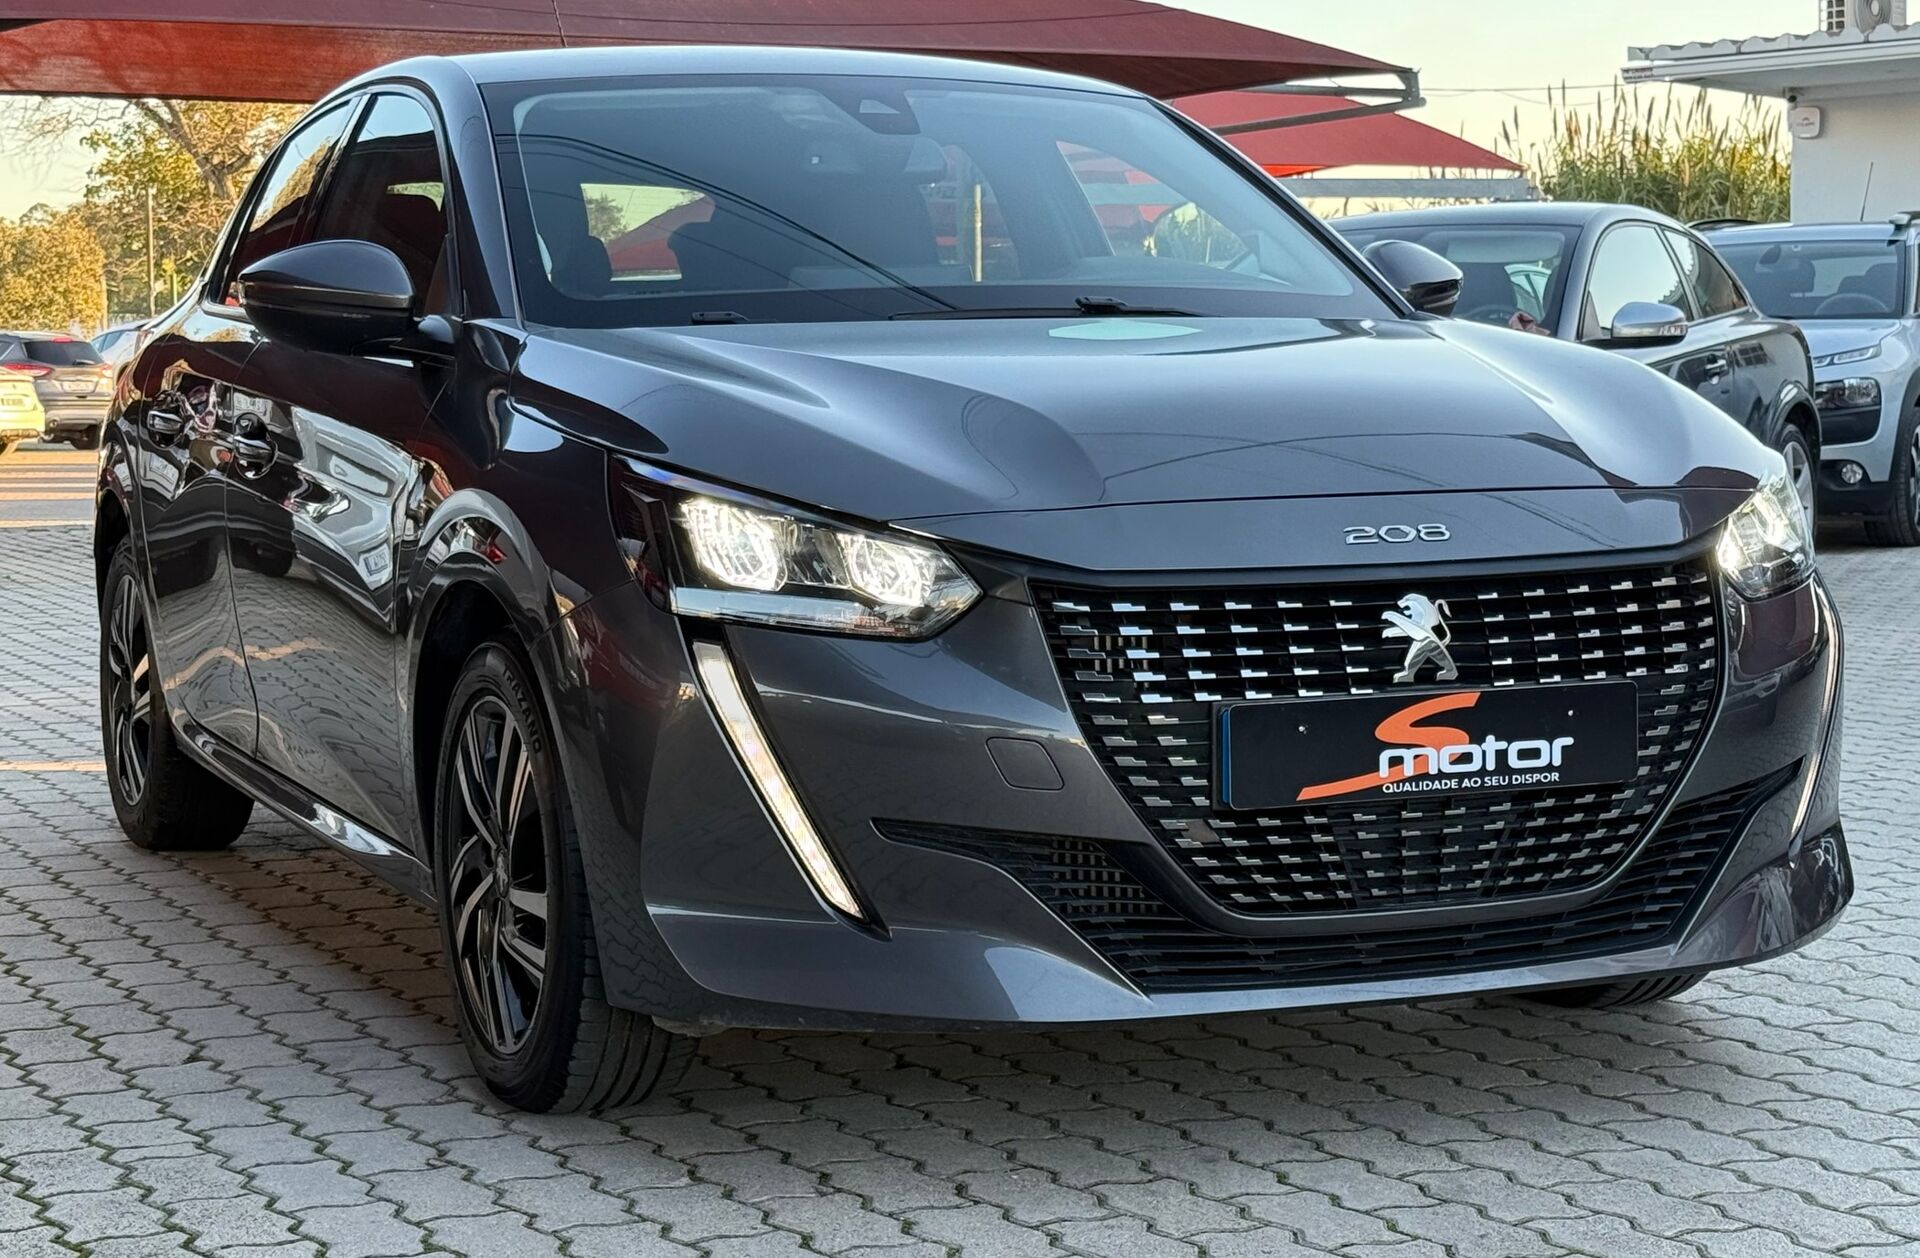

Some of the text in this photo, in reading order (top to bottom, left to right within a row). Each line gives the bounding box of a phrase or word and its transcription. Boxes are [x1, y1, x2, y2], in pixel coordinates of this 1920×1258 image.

[1344, 524, 1450, 544] 208
[503, 663, 542, 753] TRAZANO
[1379, 735, 1574, 778] motor
[1382, 772, 1560, 793] QUALIDADE AO SEU DISPOR
